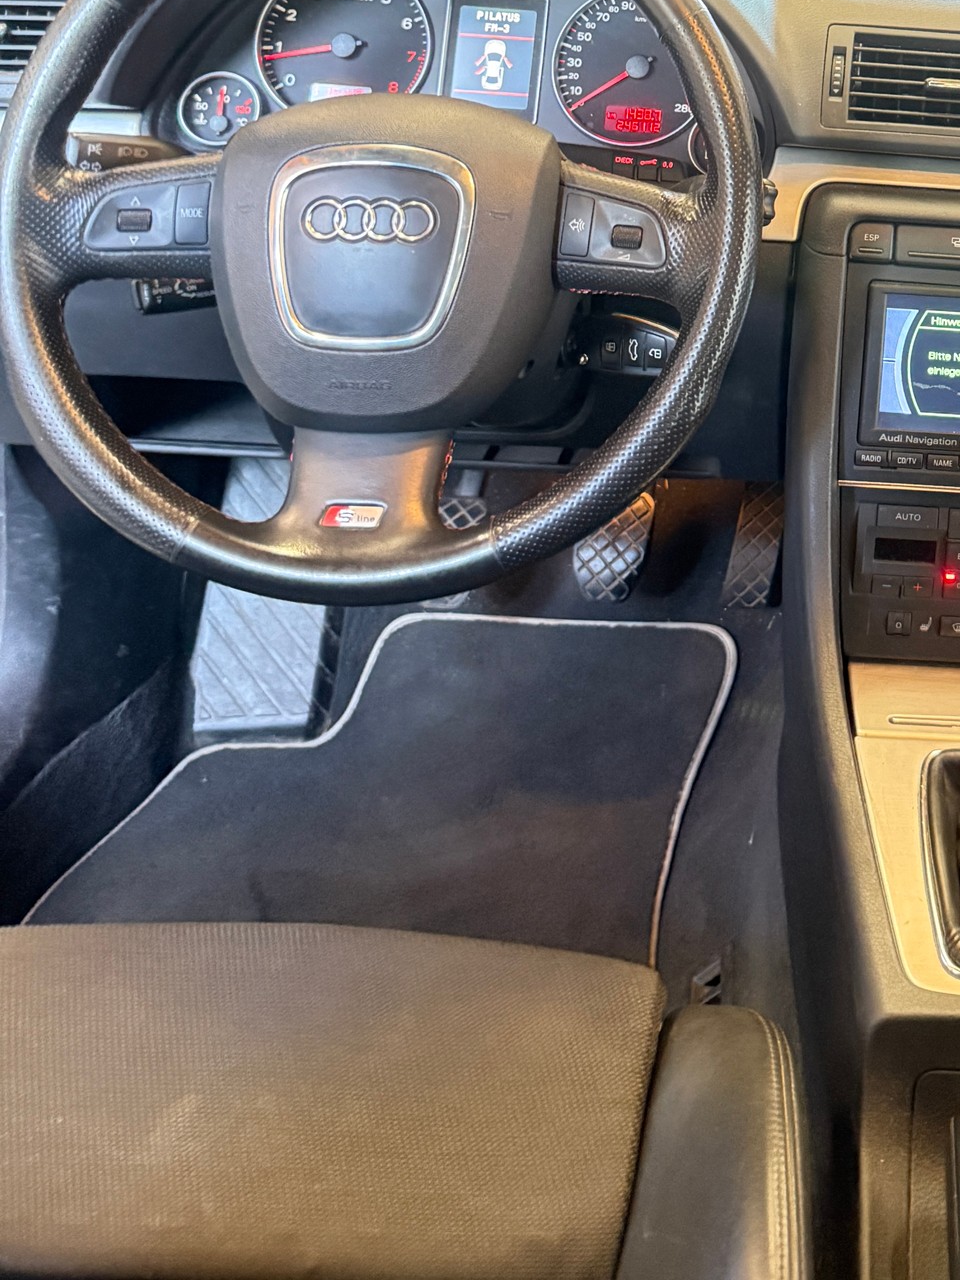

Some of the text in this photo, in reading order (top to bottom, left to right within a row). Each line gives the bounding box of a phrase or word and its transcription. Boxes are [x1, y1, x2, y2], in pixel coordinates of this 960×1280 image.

[621, 1, 636, 11] 90
[285, 9, 297, 21] 2
[476, 10, 520, 22] PILATUS
[596, 13, 610, 22] 70
[401, 18, 413, 30] 6
[484, 22, 510, 33] FM-3
[577, 32, 592, 41] 50
[275, 41, 283, 52] 1
[571, 44, 582, 52] 40
[406, 51, 416, 62] 7
[567, 58, 582, 67] 30
[285, 74, 295, 85] 0
[568, 72, 579, 80] 20
[388, 82, 398, 93] 8
[569, 86, 582, 96] 10
[180, 208, 203, 218] MODE
[864, 233, 880, 242] ESP
[928, 351, 951, 362] Bitte
[879, 433, 903, 443] Audi
[905, 435, 958, 447] Navigation
[861, 454, 882, 463] RADIO
[897, 456, 917, 466] CD/TV
[933, 459, 953, 468] NAME
[357, 513, 376, 523] line
[895, 512, 921, 522] AUTO
